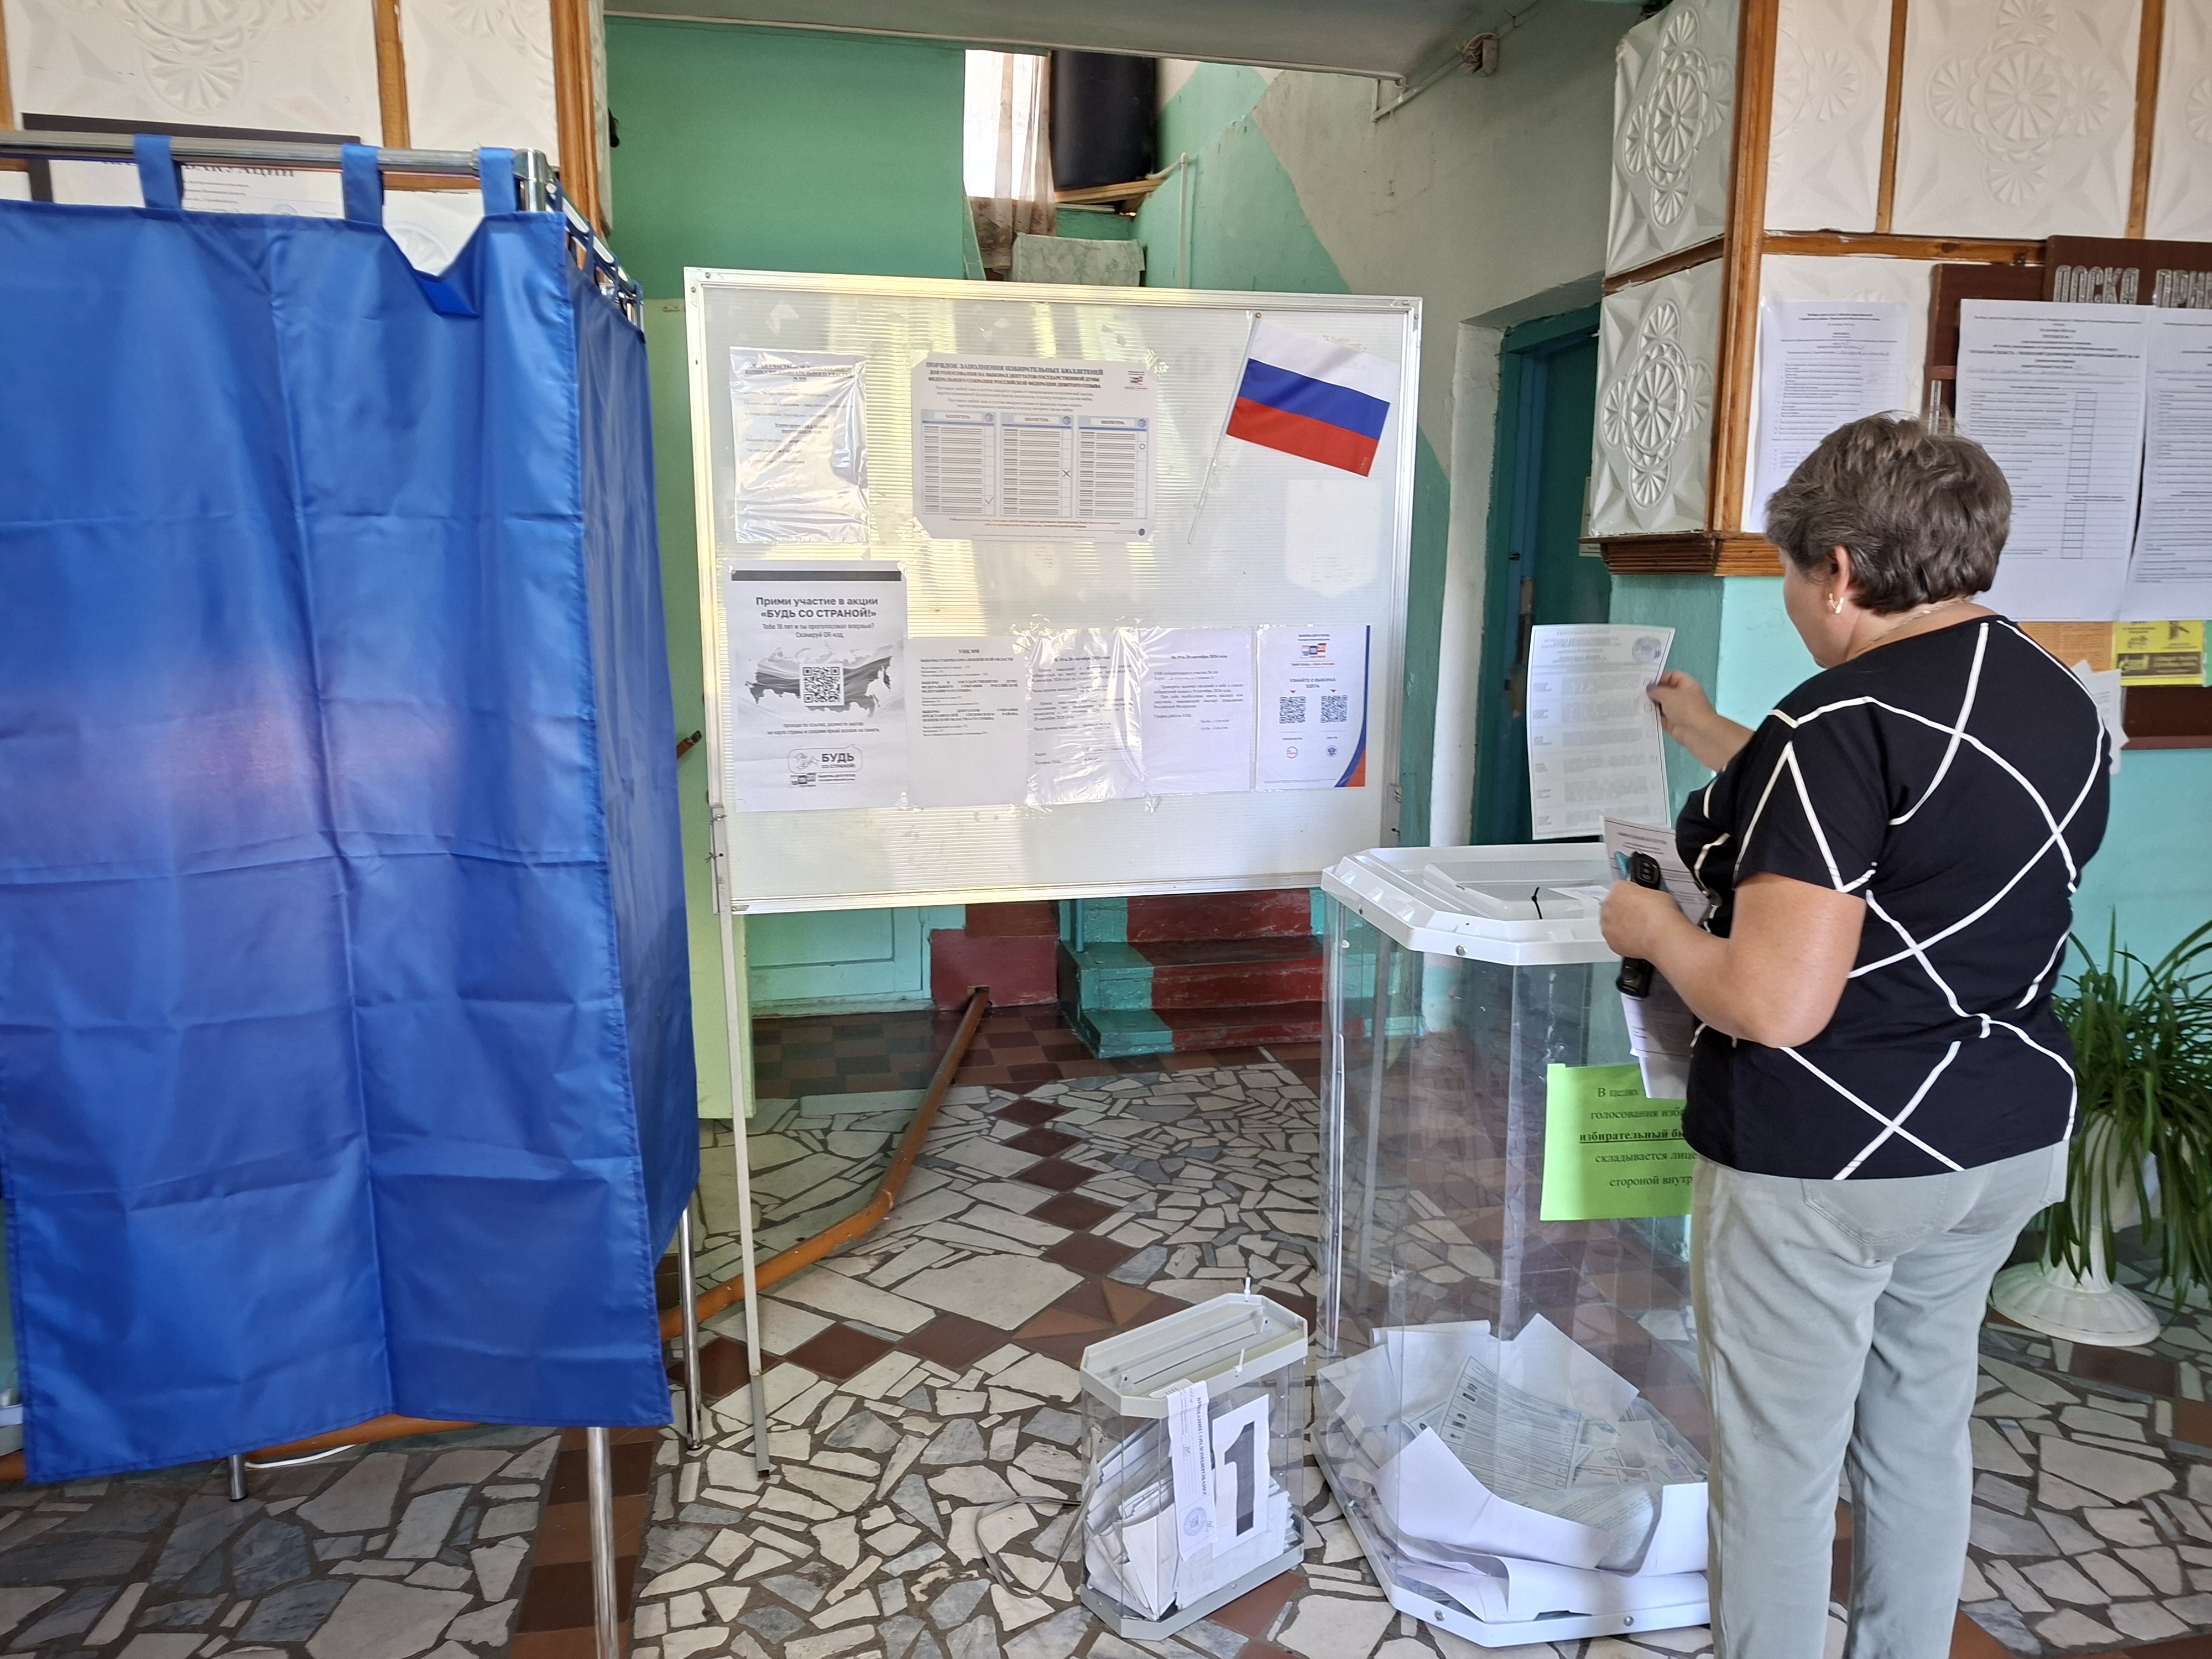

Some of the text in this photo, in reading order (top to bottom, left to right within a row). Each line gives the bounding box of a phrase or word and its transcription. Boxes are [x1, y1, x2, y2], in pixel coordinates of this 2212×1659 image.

[756, 597, 791, 607] Прими
[793, 598, 836, 607] участие
[761, 609, 796, 619] «БУДЬ
[816, 607, 877, 618] СТРАНОЙ!»
[821, 753, 854, 763] БУДЬ
[1598, 1088, 1606, 1097] В
[1590, 1110, 1658, 1120] голосования
[1579, 1130, 1668, 1142] избирательный
[1595, 1152, 1667, 1163] складывается
[1609, 1176, 1659, 1188] стороной
[1224, 1422, 1255, 1537] 1
